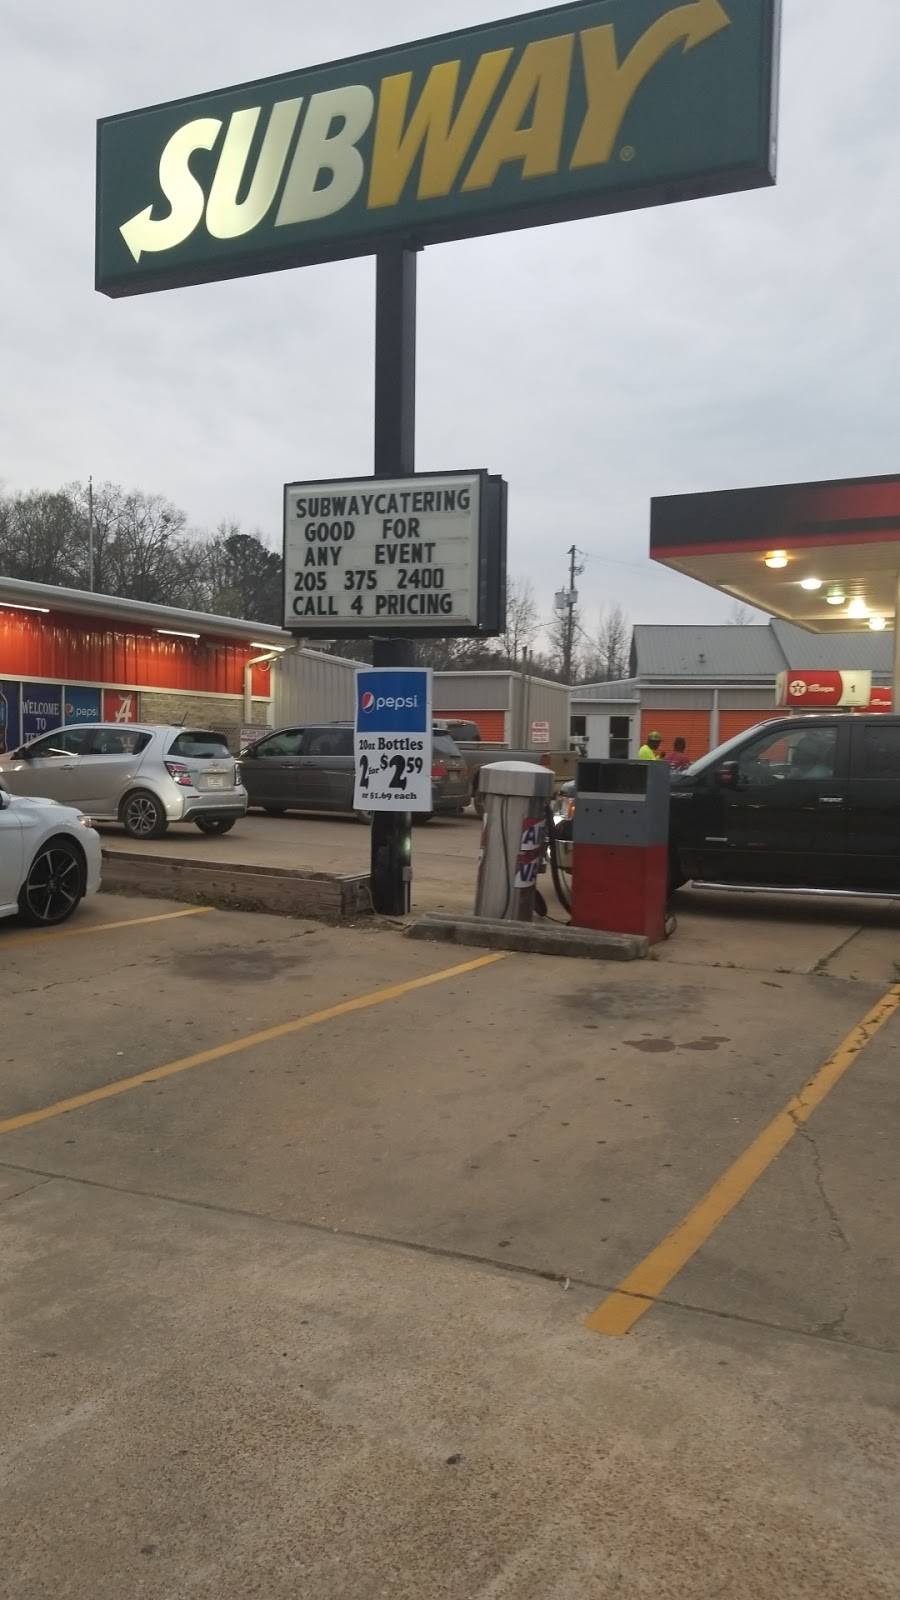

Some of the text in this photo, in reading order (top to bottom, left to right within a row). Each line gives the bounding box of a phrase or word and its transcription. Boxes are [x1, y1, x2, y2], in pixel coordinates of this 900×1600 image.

[119, 0, 731, 263] SUBWAY
[304, 517, 420, 542] GOOD FOR
[304, 542, 436, 567] ANY EVENT
[294, 568, 444, 591] 205 375 2400
[292, 593, 453, 616] CALL 4 PRICING
[22, 700, 59, 716] WELCOME
[375, 694, 418, 711] pepsi
[36, 717, 47, 730] TO
[377, 737, 423, 751] Bottles
[359, 754, 369, 790] 2
[394, 792, 417, 800] each
